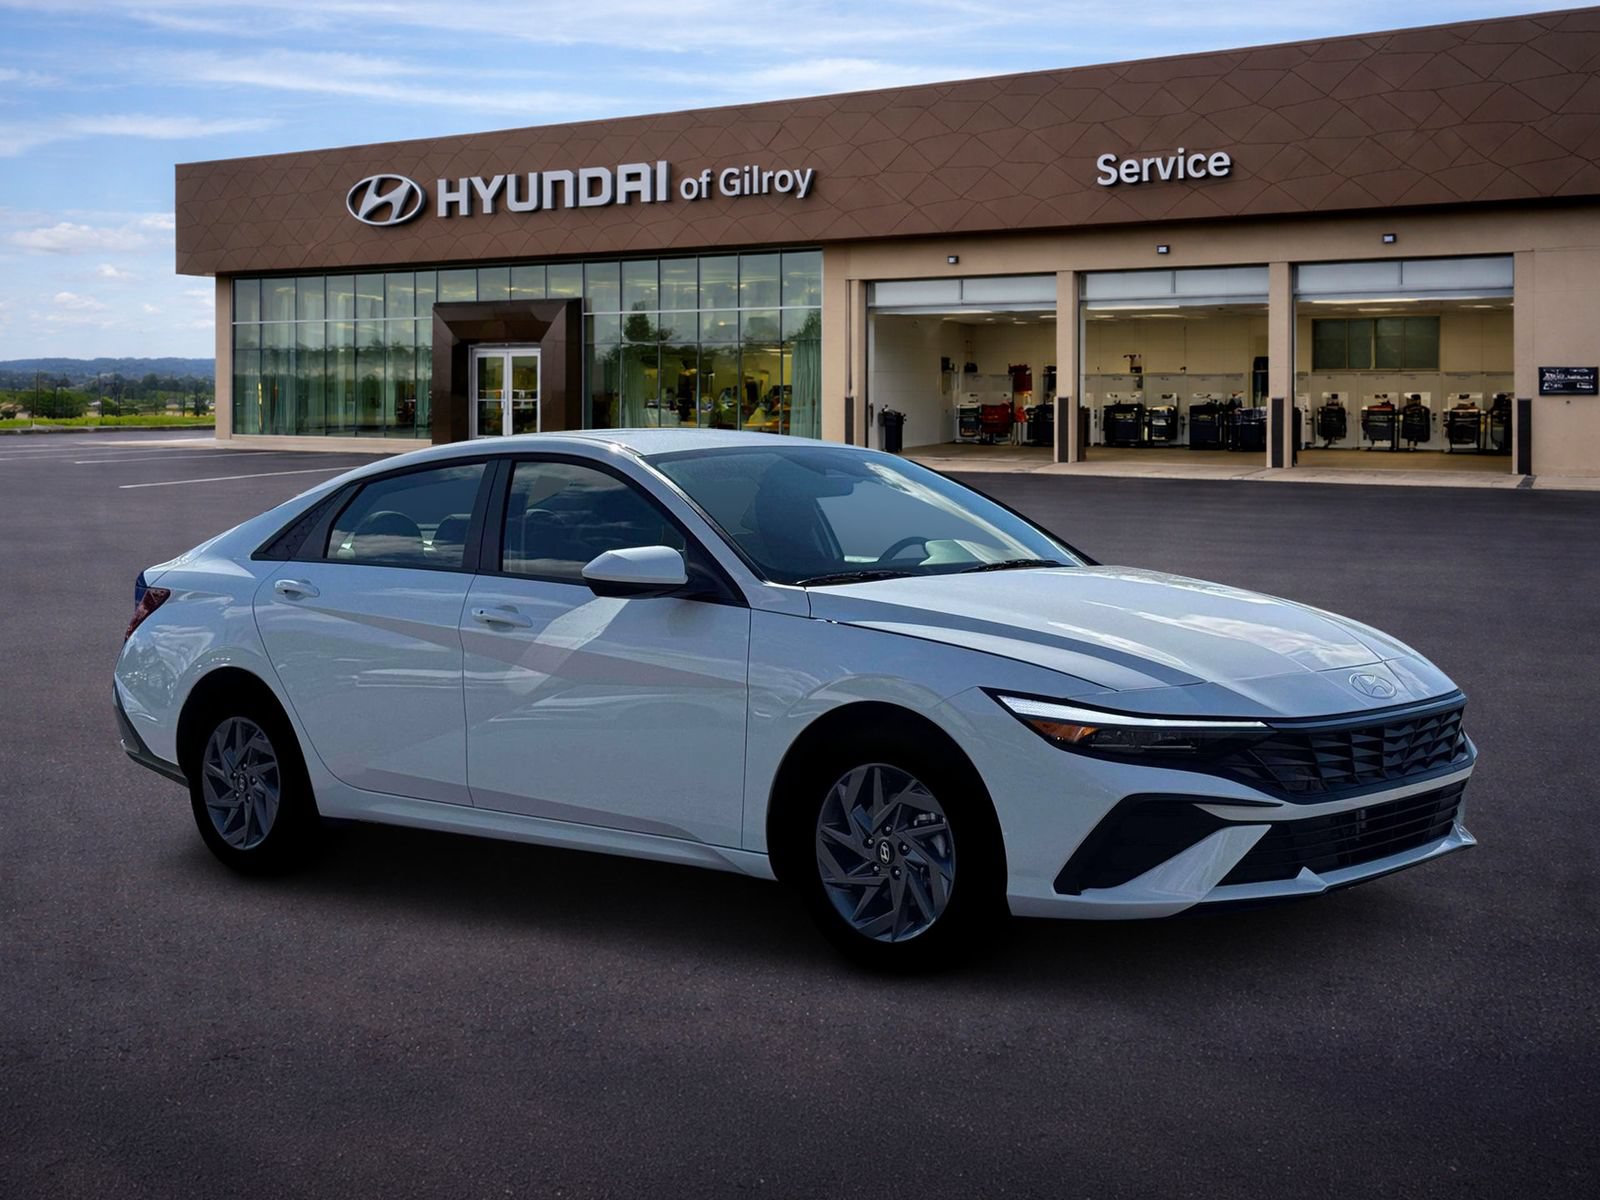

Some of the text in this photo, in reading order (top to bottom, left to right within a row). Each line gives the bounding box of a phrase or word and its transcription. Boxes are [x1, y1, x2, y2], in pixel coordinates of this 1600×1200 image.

[436, 160, 814, 218] HYUNDAI of Gilroy
[1096, 147, 1232, 187] Service
